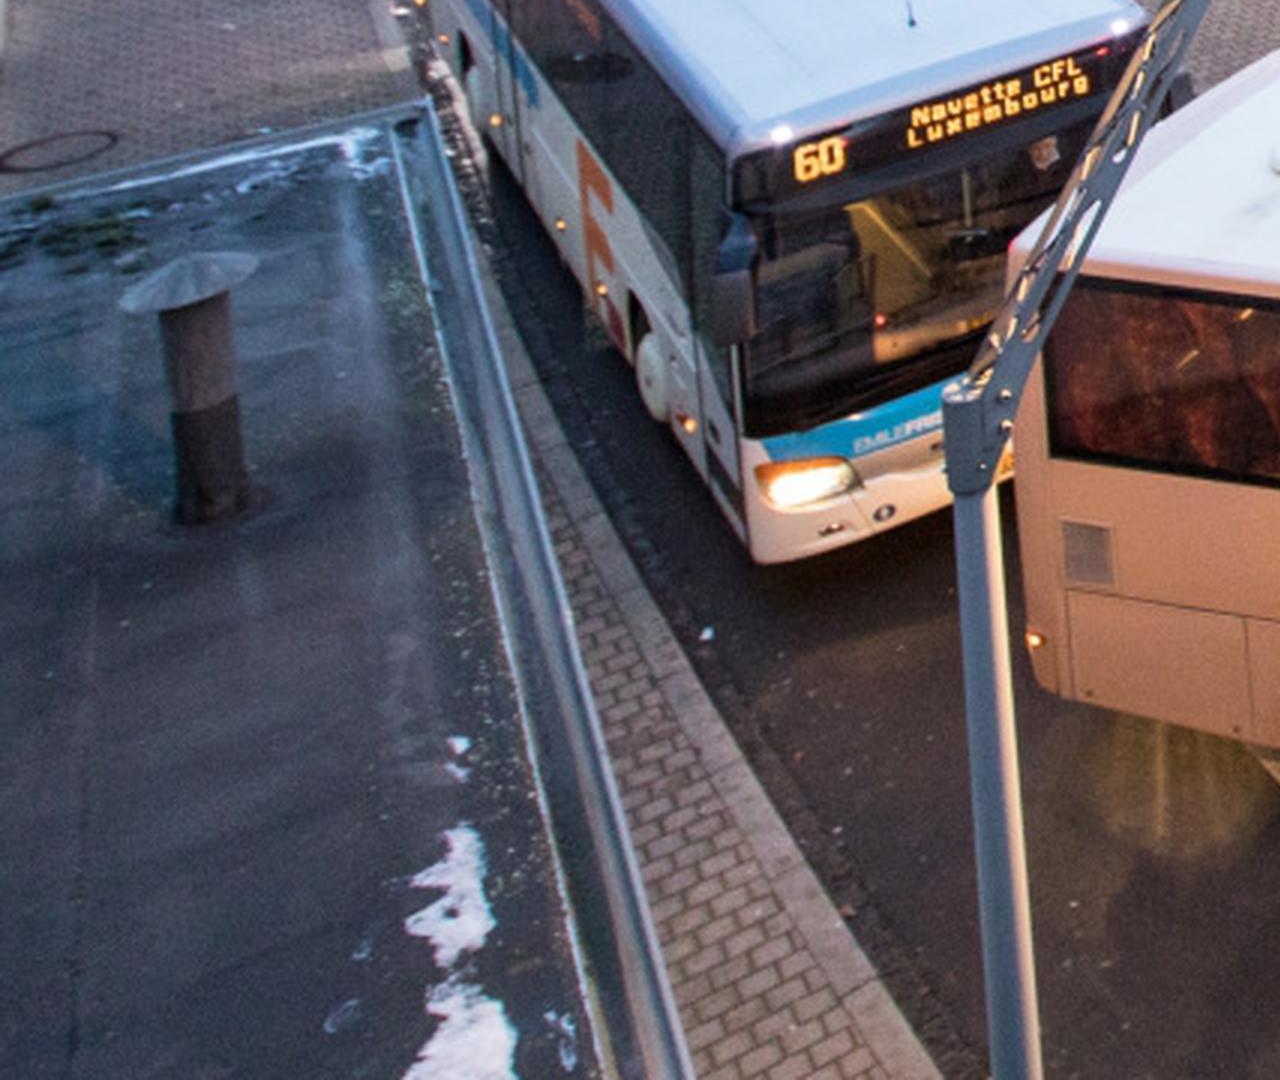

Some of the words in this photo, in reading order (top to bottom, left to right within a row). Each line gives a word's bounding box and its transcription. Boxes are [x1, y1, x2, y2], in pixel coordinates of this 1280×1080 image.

[905, 73, 1090, 150] Luxembourg
[910, 78, 1022, 128] Navette
[1033, 56, 1082, 88] CFL
[792, 135, 847, 183] 60
